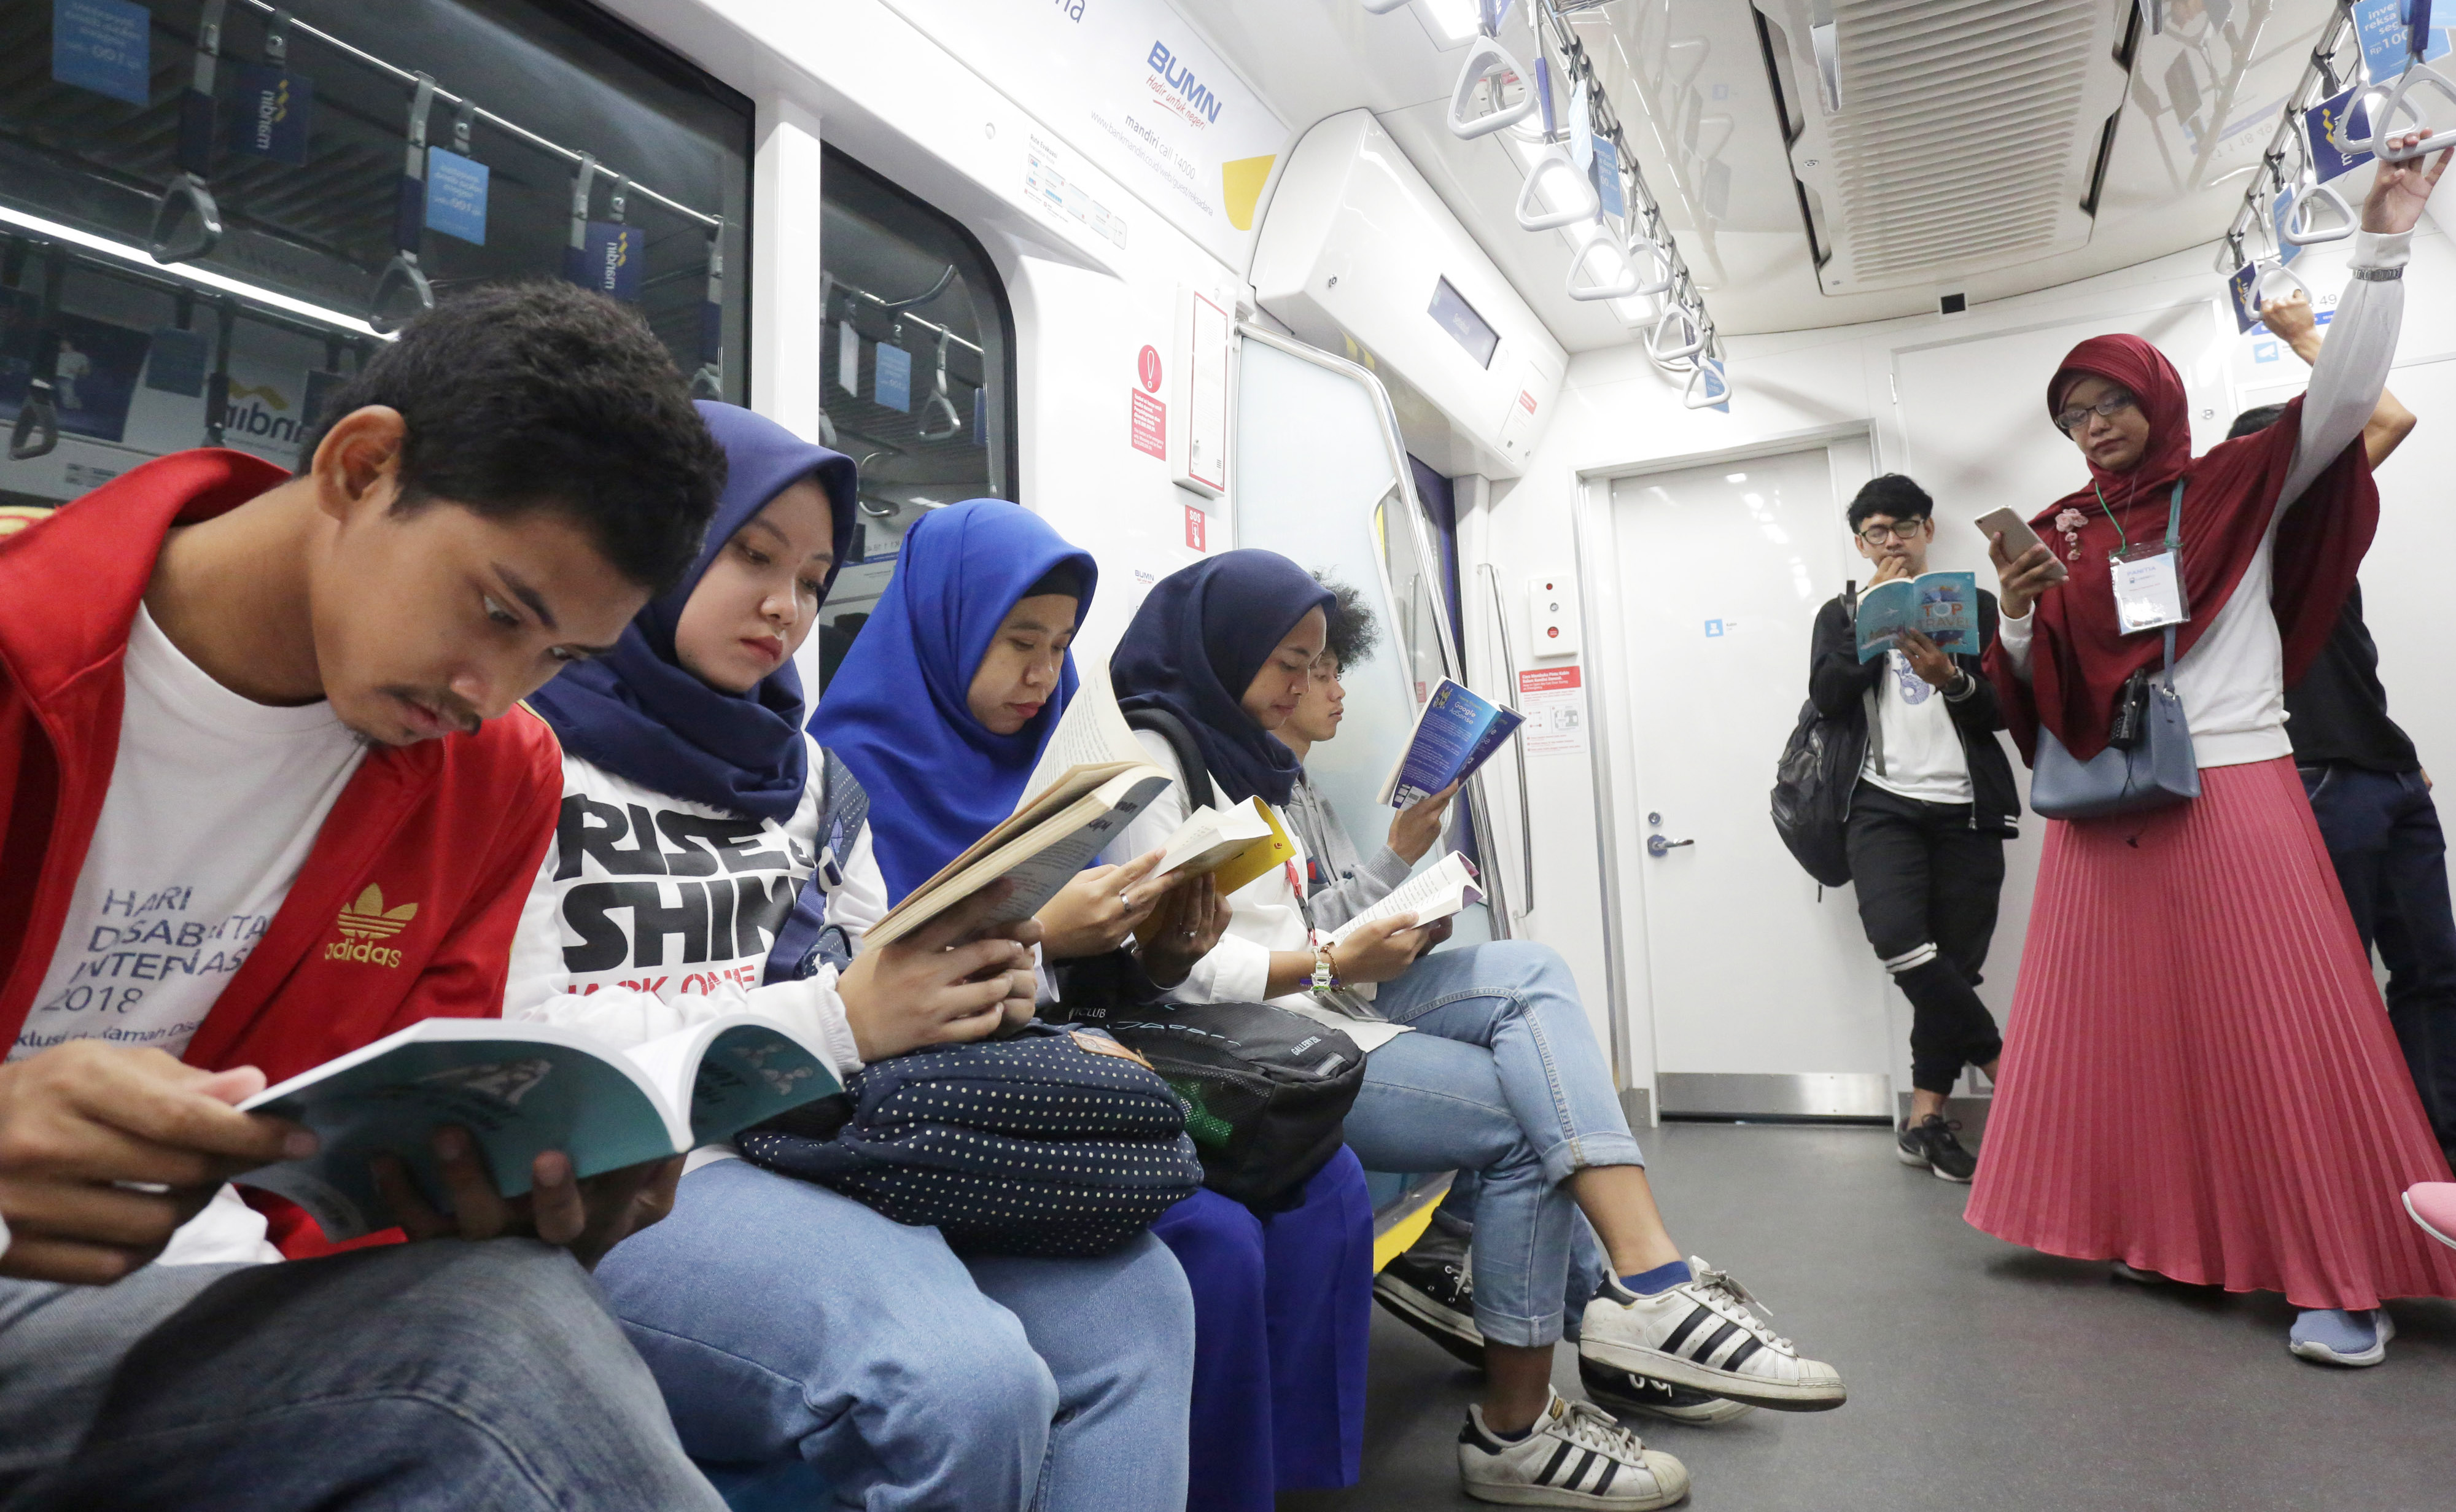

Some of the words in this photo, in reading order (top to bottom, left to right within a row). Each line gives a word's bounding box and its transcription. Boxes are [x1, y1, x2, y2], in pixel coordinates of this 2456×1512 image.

[1147, 40, 1222, 124] BUMN
[1146, 74, 1167, 96] Hadir
[1165, 93, 1187, 114] untuk
[1184, 110, 1207, 130] negeri
[1125, 115, 1160, 149] mandiri
[1159, 144, 1174, 161] call
[1173, 153, 1196, 180] 14000
[2319, 293, 2337, 306] 49
[1189, 510, 1201, 524] SOS
[1135, 570, 1154, 581] BUMN
[1449, 707, 1474, 725] AdSense
[1455, 702, 1477, 718] Google
[553, 793, 790, 882] RISE
[102, 886, 193, 917] HARI
[562, 875, 809, 973] SHIN
[325, 939, 402, 968] adidas
[41, 985, 143, 1013] 2018
[1291, 1038, 1315, 1056] GALLERY
